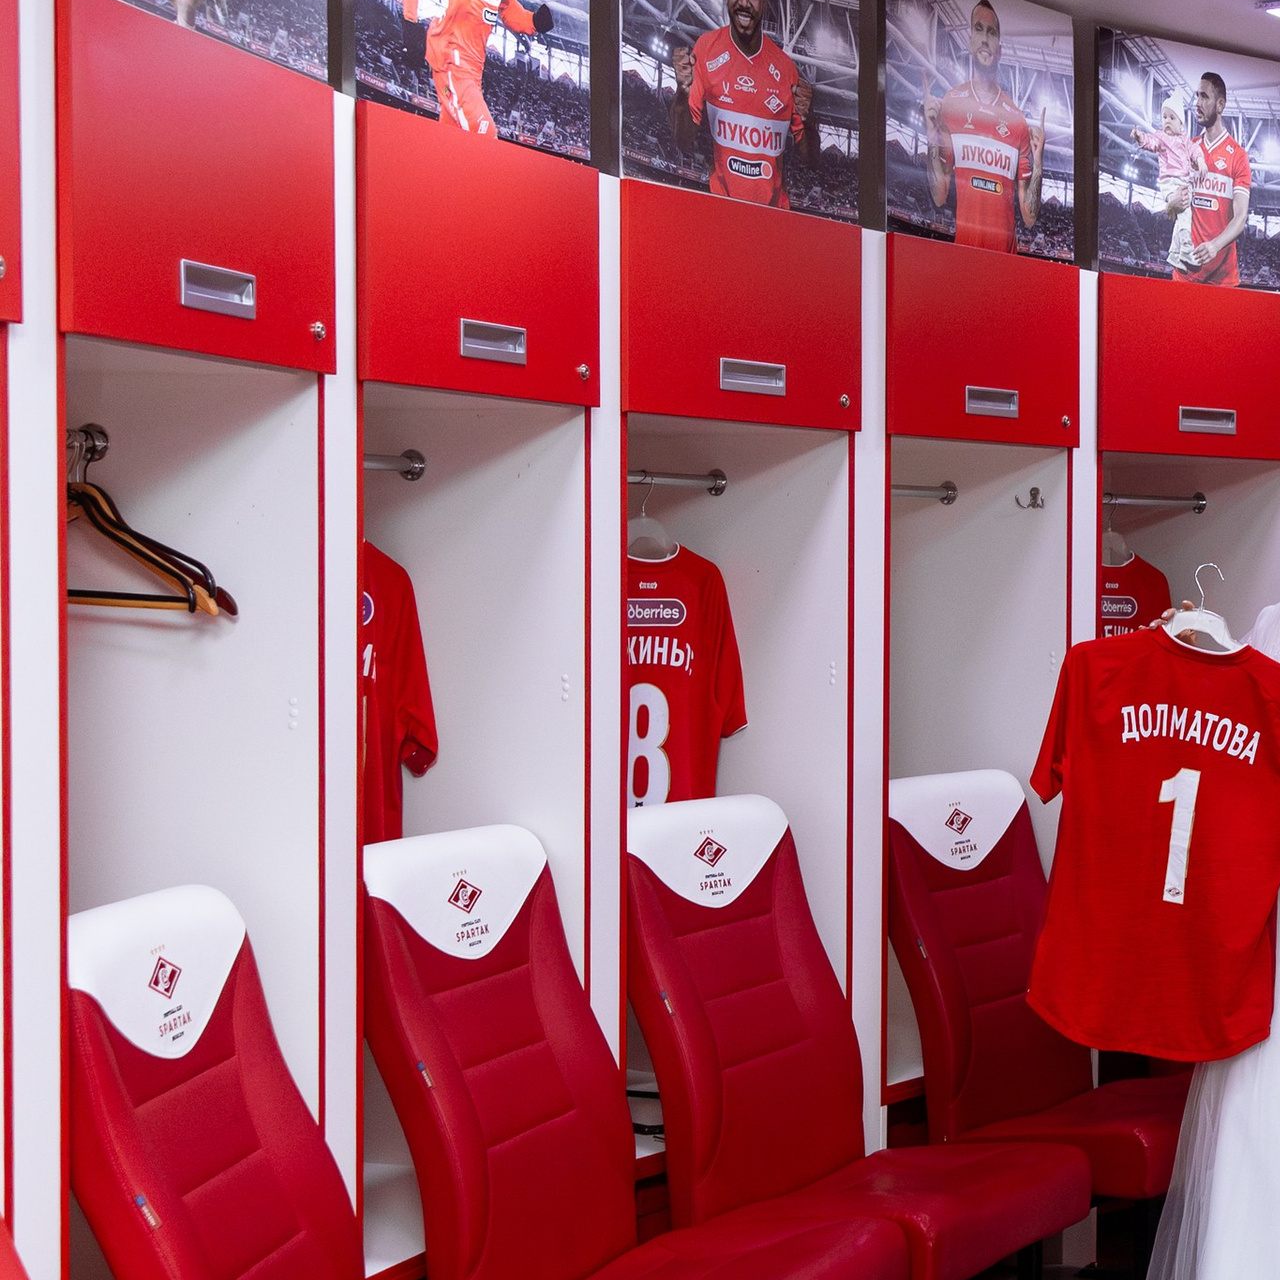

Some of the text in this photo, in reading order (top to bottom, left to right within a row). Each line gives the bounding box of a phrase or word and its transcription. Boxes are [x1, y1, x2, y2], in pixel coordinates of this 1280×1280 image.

[717, 119, 782, 151] ЛУКОЙЛ
[731, 160, 760, 175] Winline
[961, 144, 1011, 172] ЛУКОЙЛ
[1193, 176, 1227, 194] УКОЙЛ
[628, 604, 680, 619] dberries
[1121, 703, 1261, 765] ДОЛМАТОВА
[1158, 767, 1202, 905] 1
[950, 843, 978, 856] SPARTAK
[700, 878, 732, 891] SPARTAK
[456, 924, 490, 943] SPARTAK
[158, 1011, 193, 1038] SPARTAK
